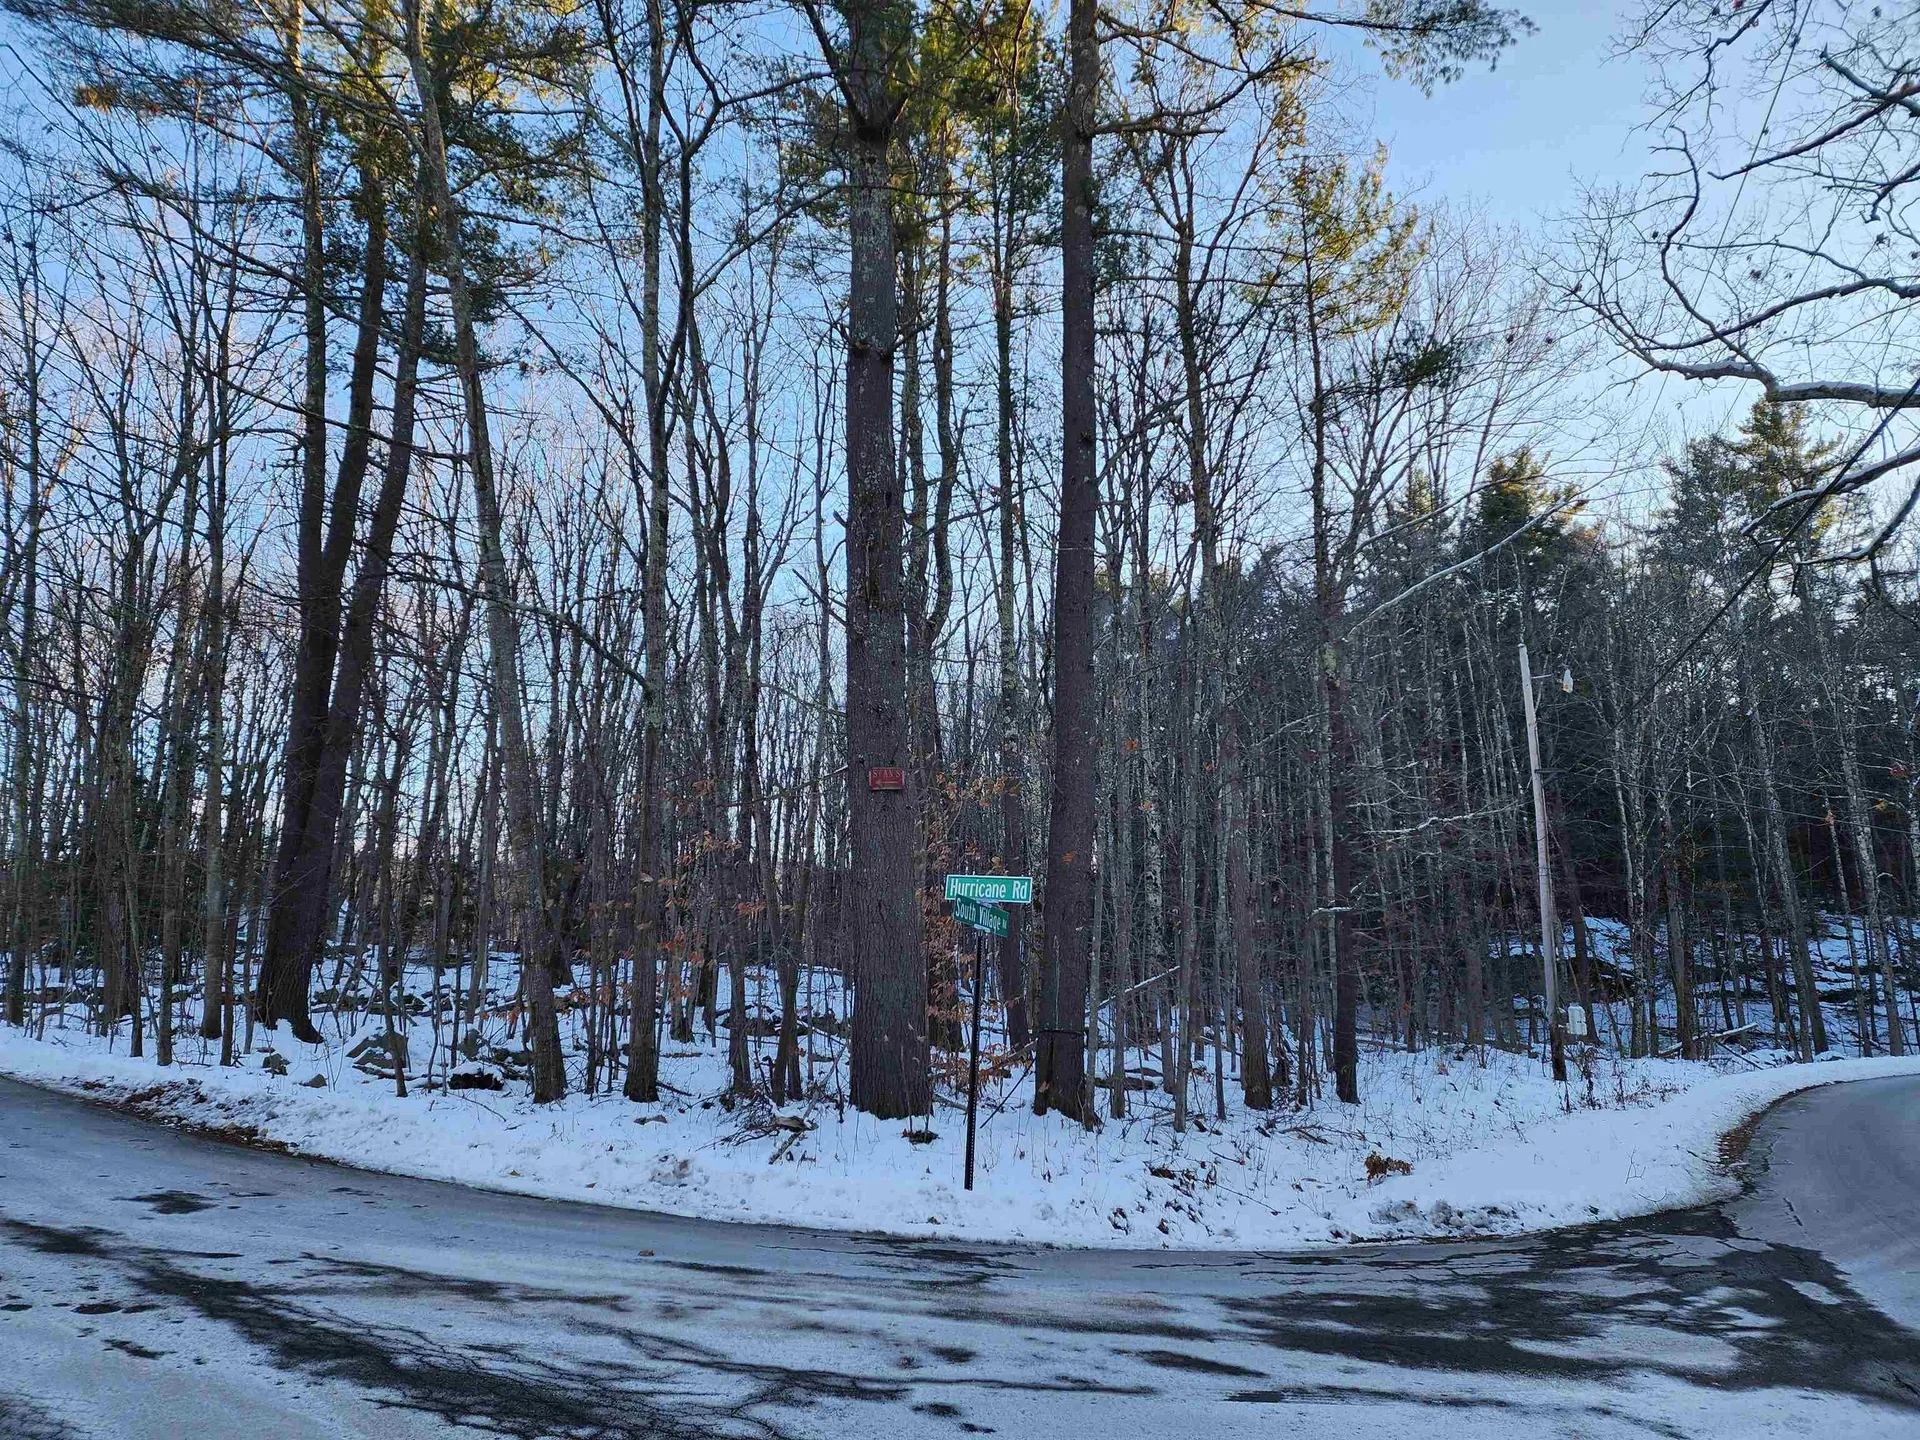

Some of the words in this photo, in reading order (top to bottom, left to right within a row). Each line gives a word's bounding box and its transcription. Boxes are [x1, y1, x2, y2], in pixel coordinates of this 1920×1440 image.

[950, 878, 1006, 898] Hurricane
[1012, 880, 1028, 899] Rd
[955, 897, 976, 922] South
[979, 905, 1001, 933] Village
